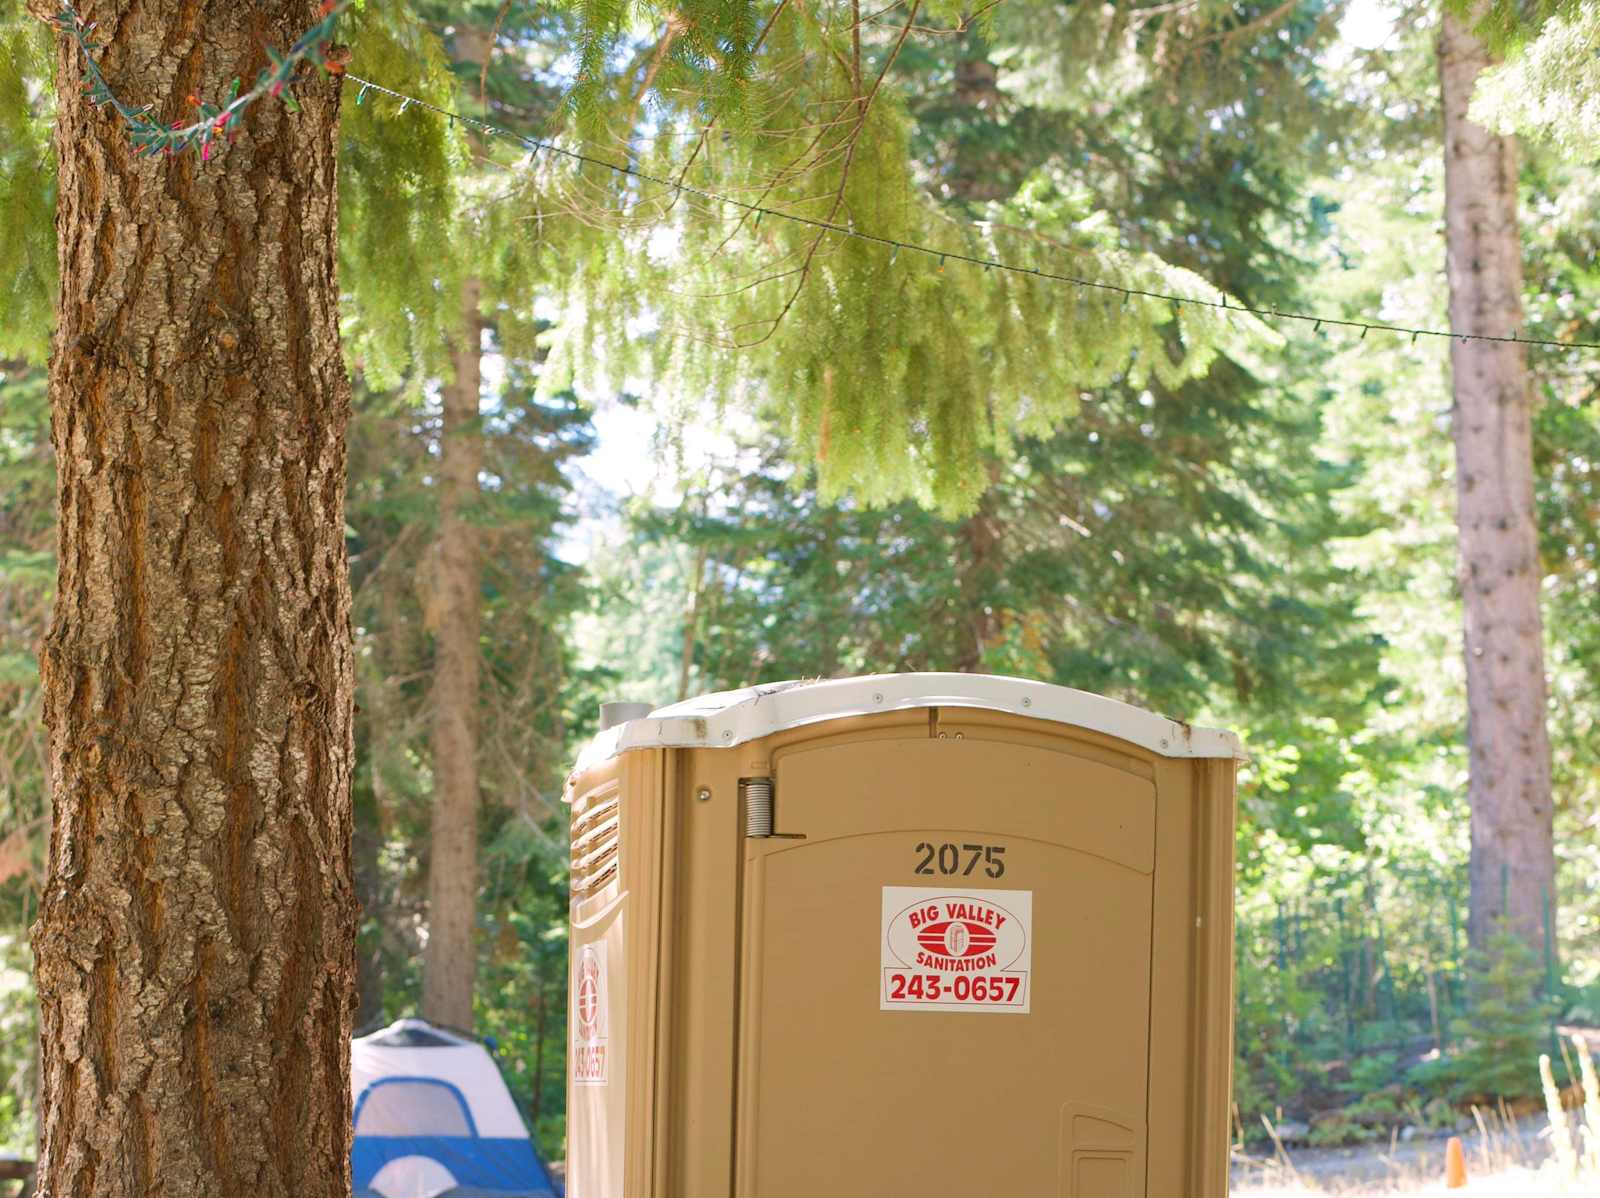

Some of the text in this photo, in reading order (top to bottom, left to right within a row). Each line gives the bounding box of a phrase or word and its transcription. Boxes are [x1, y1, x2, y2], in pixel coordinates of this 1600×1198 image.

[914, 842, 1006, 879] 2075
[908, 903, 1007, 930] BIG VALLEY
[916, 951, 997, 972] SANITATION
[891, 974, 1020, 1002] 243-0657
